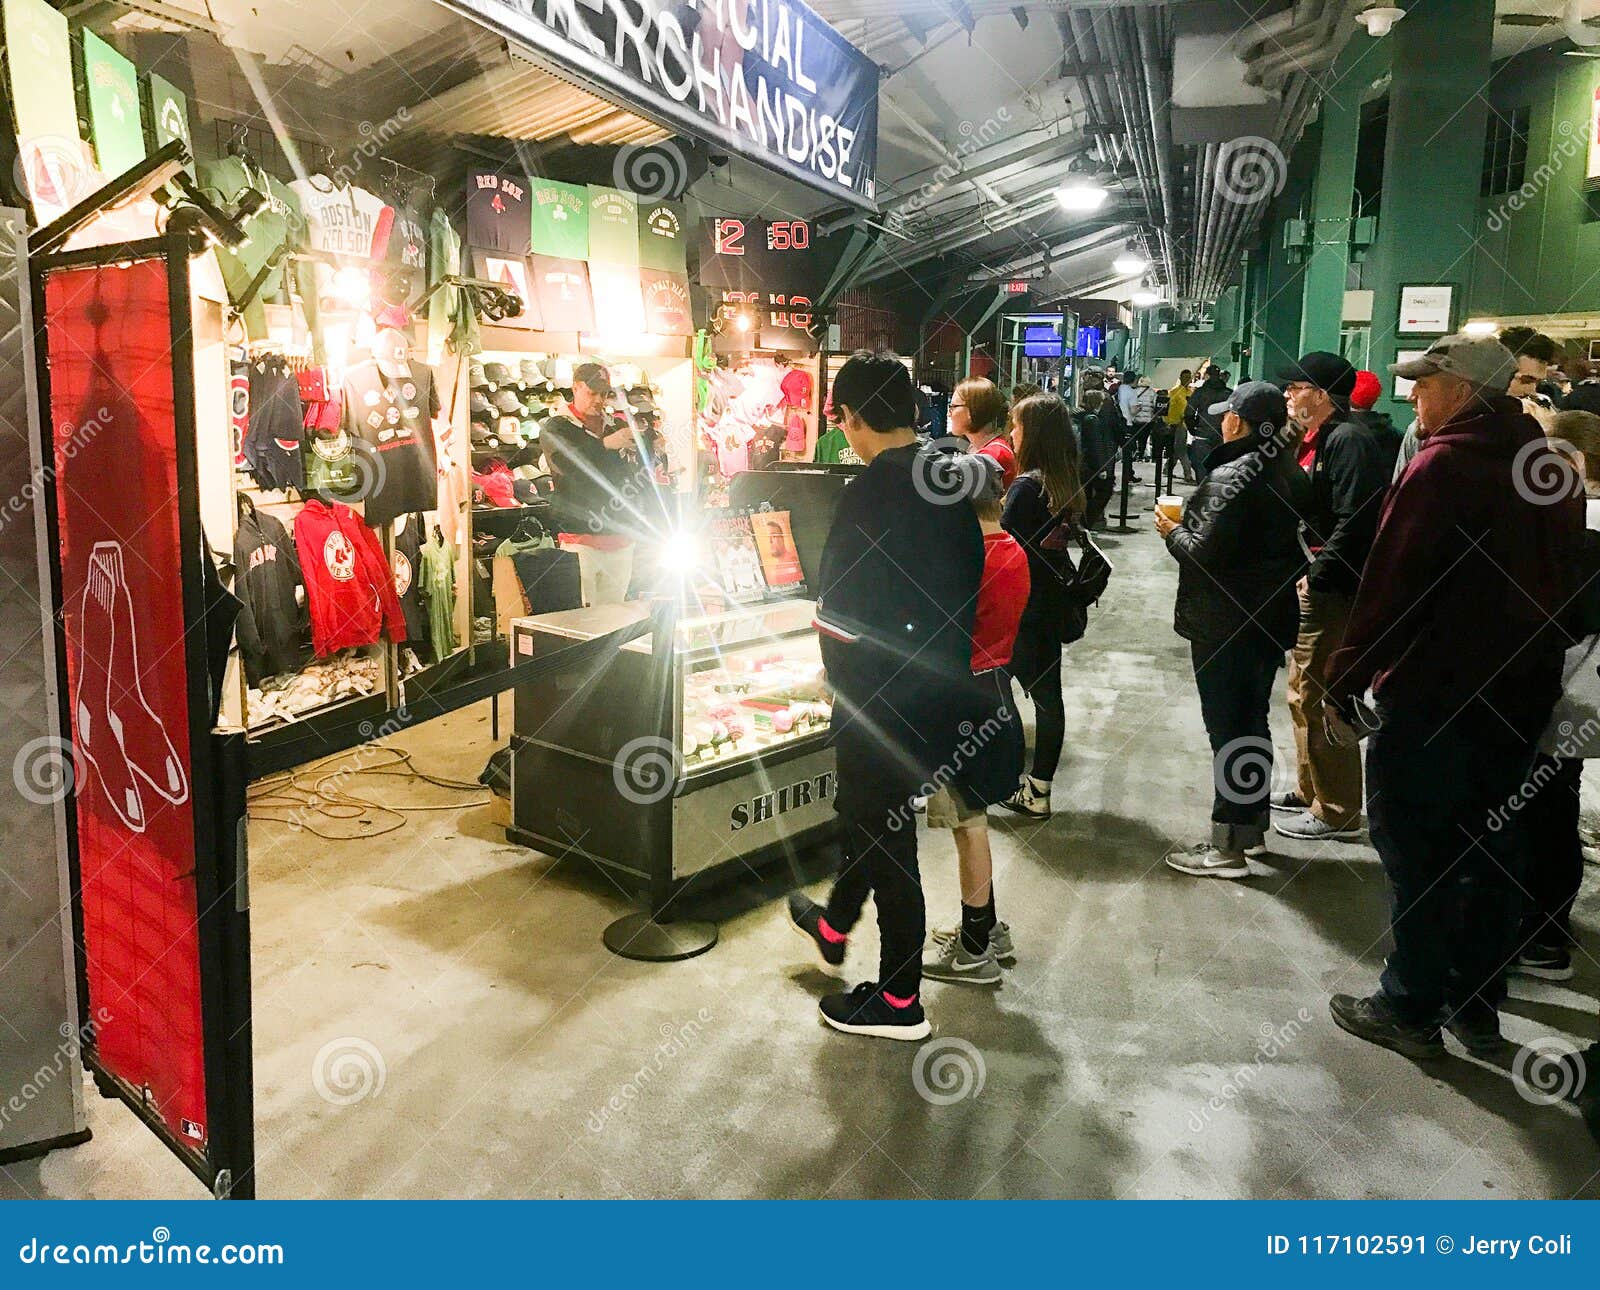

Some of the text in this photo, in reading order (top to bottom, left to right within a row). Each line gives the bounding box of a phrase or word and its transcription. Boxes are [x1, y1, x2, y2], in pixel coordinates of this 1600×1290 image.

[321, 203, 372, 234] BOSTON
[720, 219, 745, 255] 2
[772, 221, 809, 250] 50
